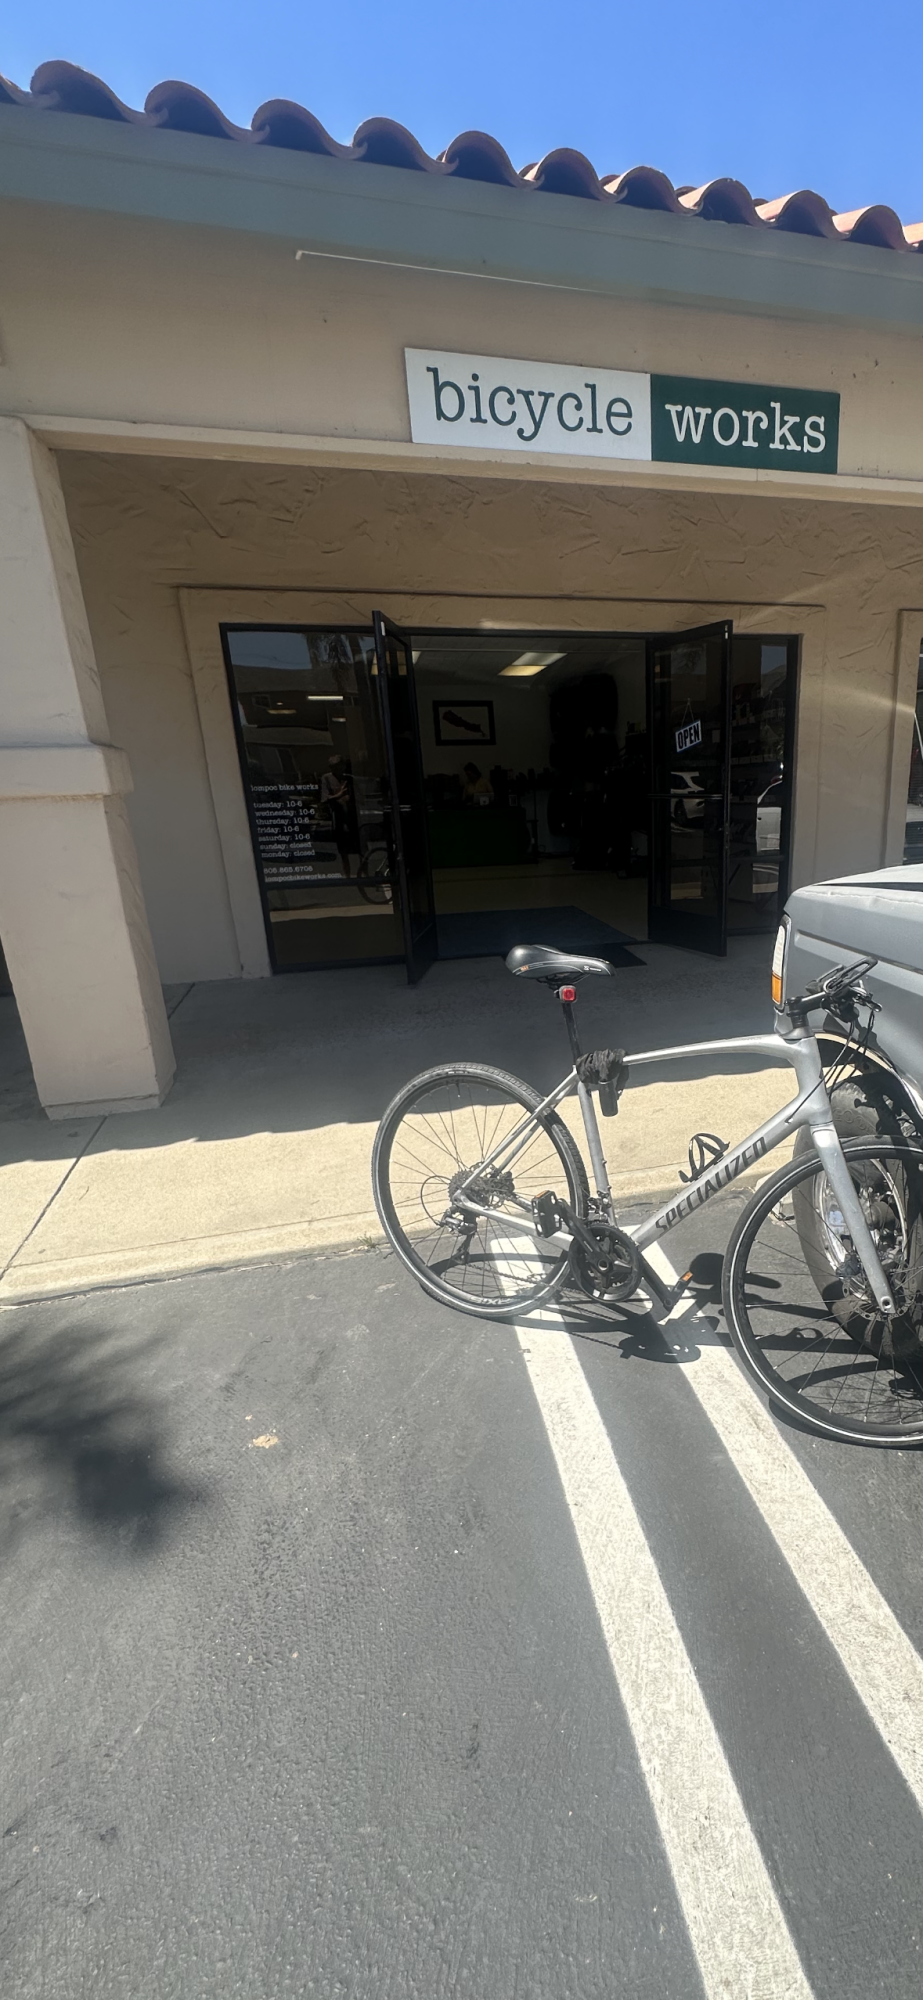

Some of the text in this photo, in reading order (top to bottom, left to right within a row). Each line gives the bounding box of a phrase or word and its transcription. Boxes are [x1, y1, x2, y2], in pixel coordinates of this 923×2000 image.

[427, 366, 826, 453] bicycle works
[677, 723, 700, 749] OPEN
[265, 873, 342, 882] lompocbikeworks.com
[655, 1136, 767, 1232] SPECIALIZED
